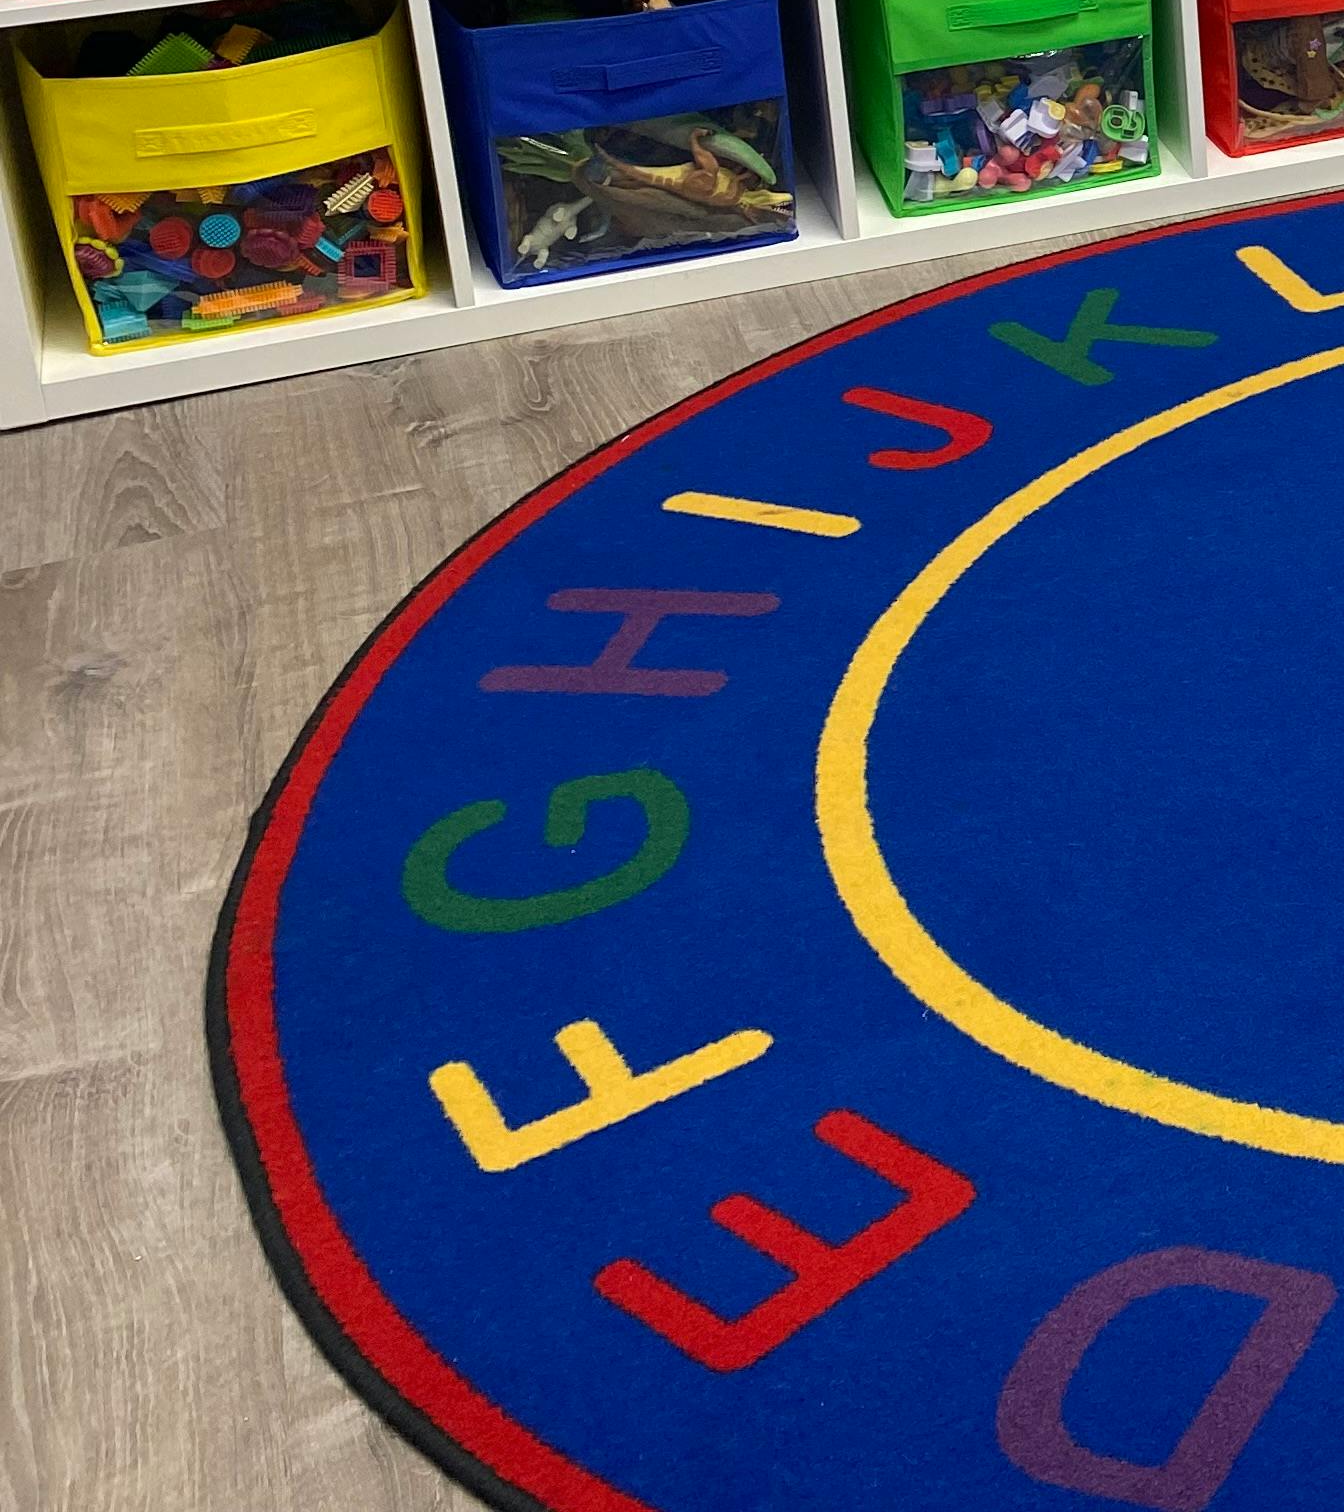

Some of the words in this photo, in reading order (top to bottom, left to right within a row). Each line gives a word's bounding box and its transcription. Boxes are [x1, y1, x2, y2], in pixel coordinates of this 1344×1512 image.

[987, 286, 1219, 388] K
[841, 385, 993, 472] J
[660, 490, 862, 541] I
[479, 587, 779, 697] H
[401, 766, 692, 934] G
[428, 1017, 775, 1174] F
[592, 1109, 977, 1373] E
[998, 1246, 1338, 1512] D
